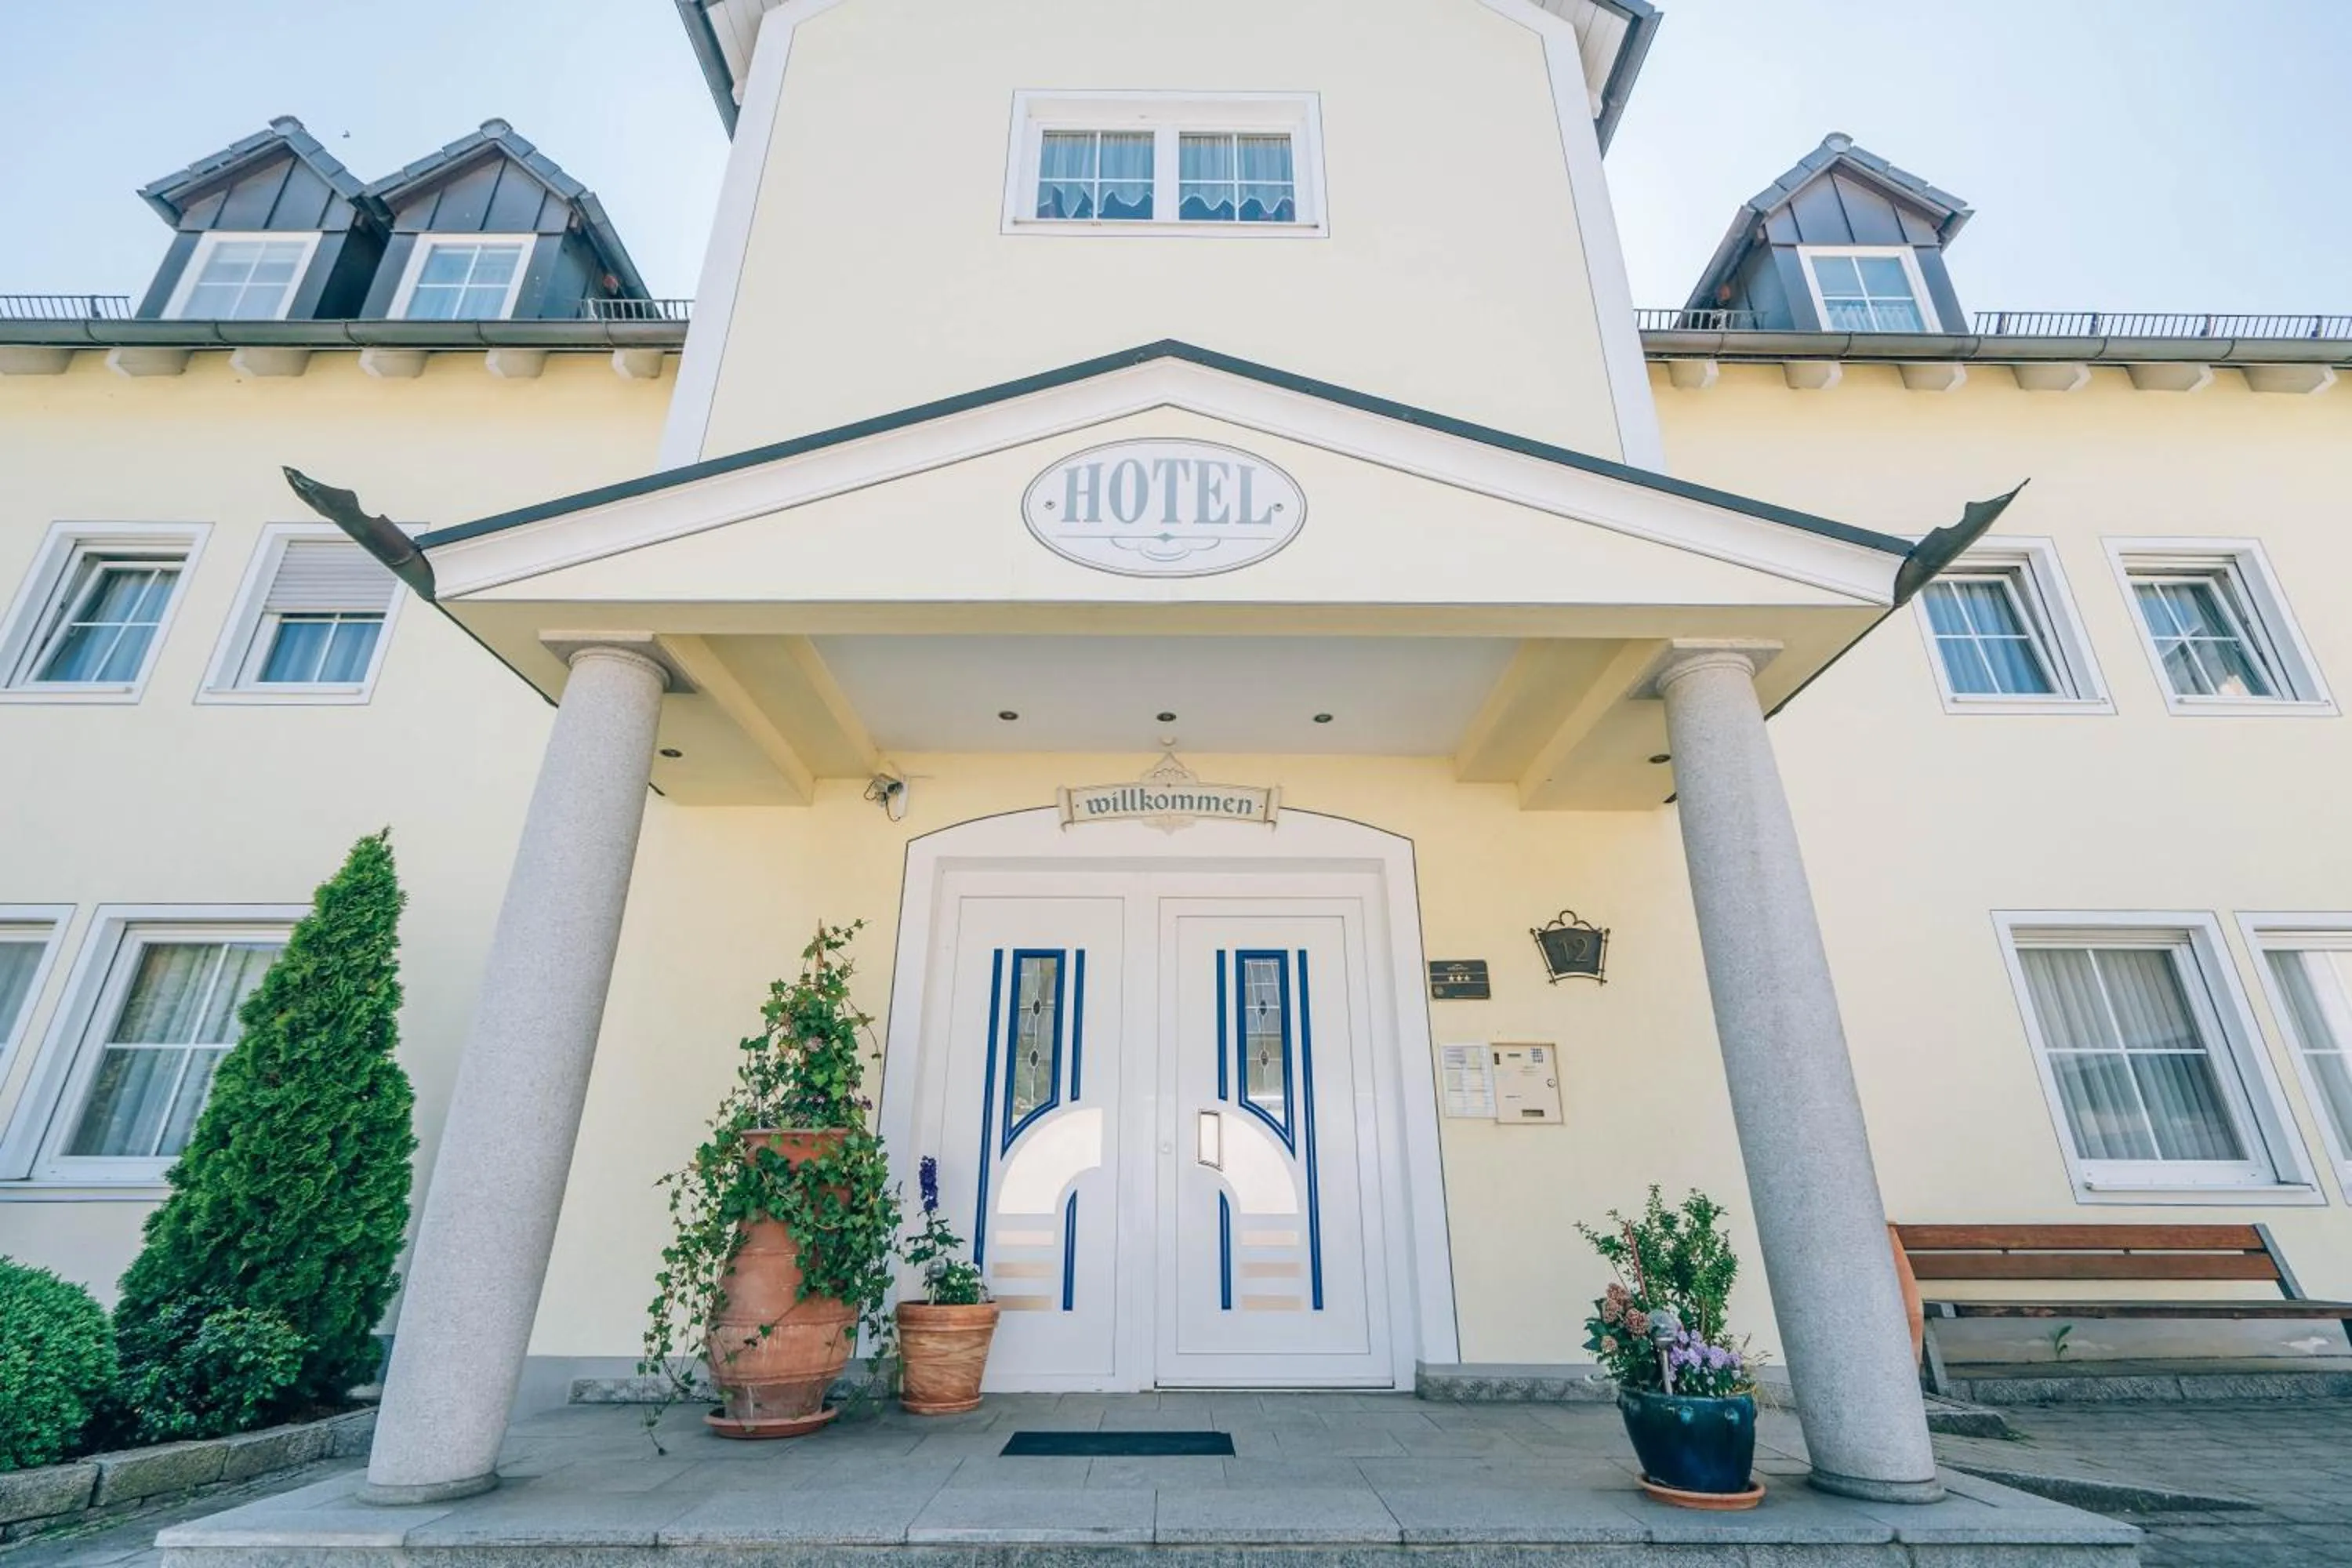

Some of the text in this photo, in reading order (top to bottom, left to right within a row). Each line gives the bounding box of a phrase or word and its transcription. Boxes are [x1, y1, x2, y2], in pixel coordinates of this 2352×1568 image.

[1061, 458, 1273, 524] HOTEL
[1085, 788, 1253, 815] willkommen
[1559, 937, 1588, 963] 12
